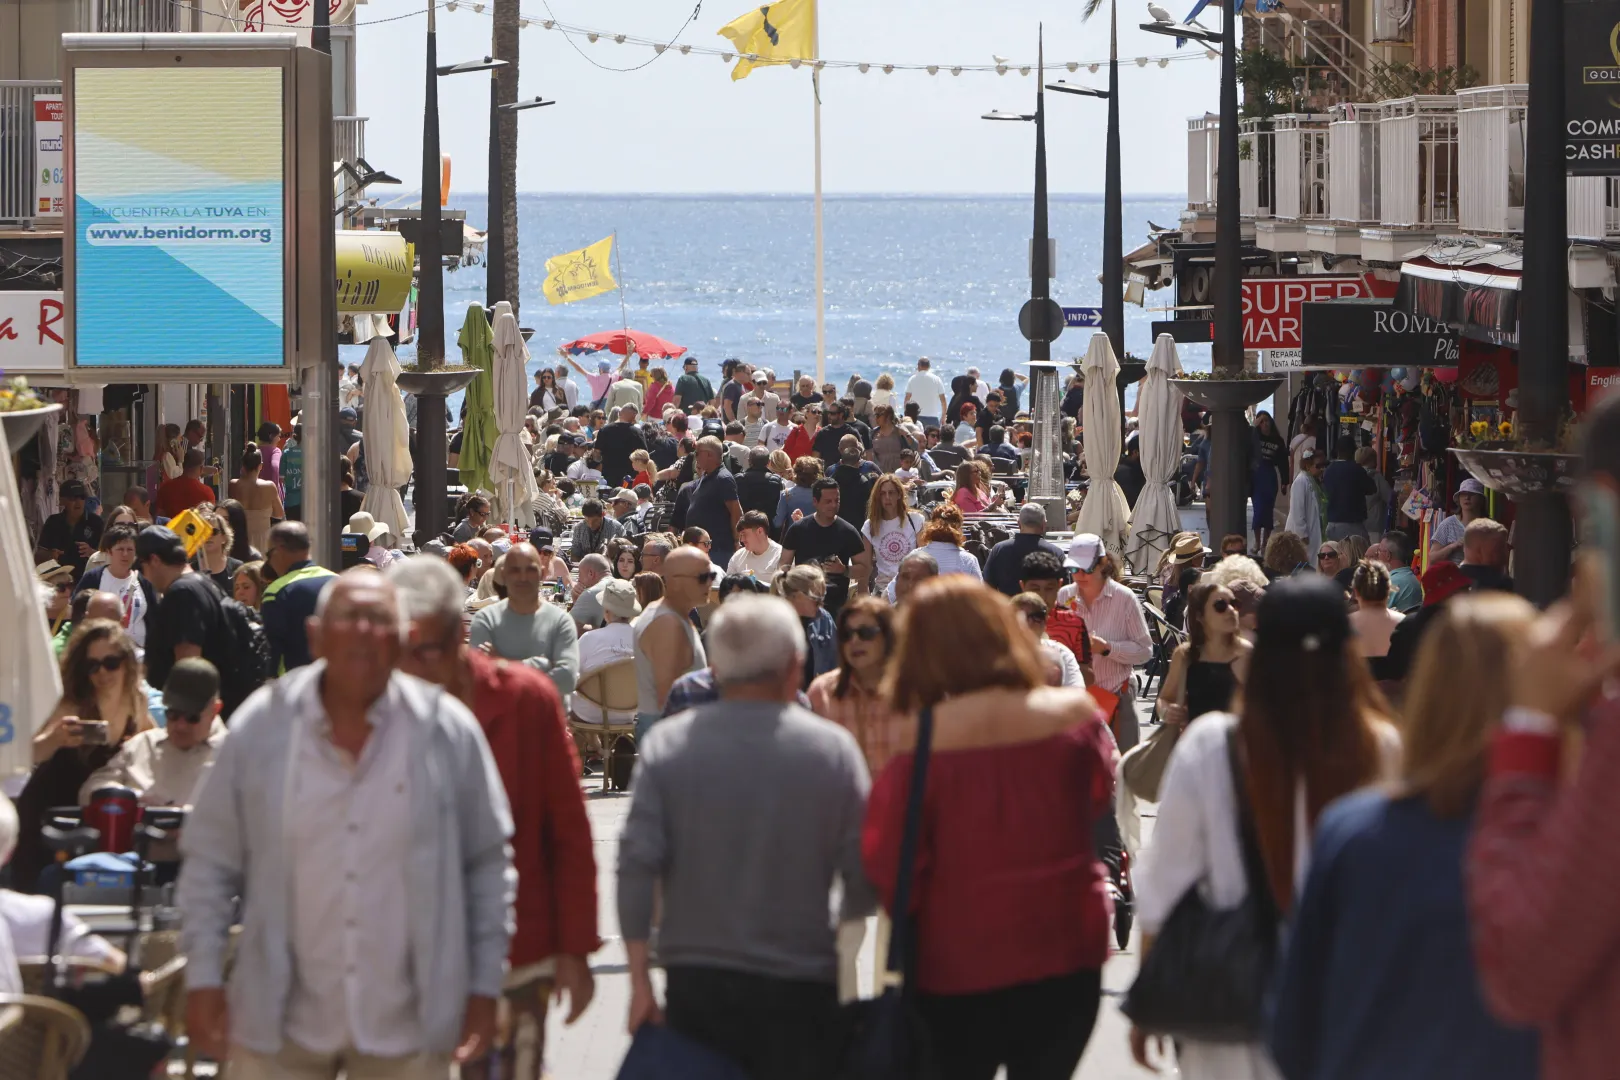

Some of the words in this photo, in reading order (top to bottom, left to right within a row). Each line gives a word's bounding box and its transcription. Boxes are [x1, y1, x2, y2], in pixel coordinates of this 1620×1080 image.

[92, 206, 178, 217] ENCUENTRA
[183, 206, 201, 217] LA
[204, 206, 243, 217] TUYA
[90, 225, 271, 243] www.benidorm.org
[1068, 313, 1088, 321] INFO
